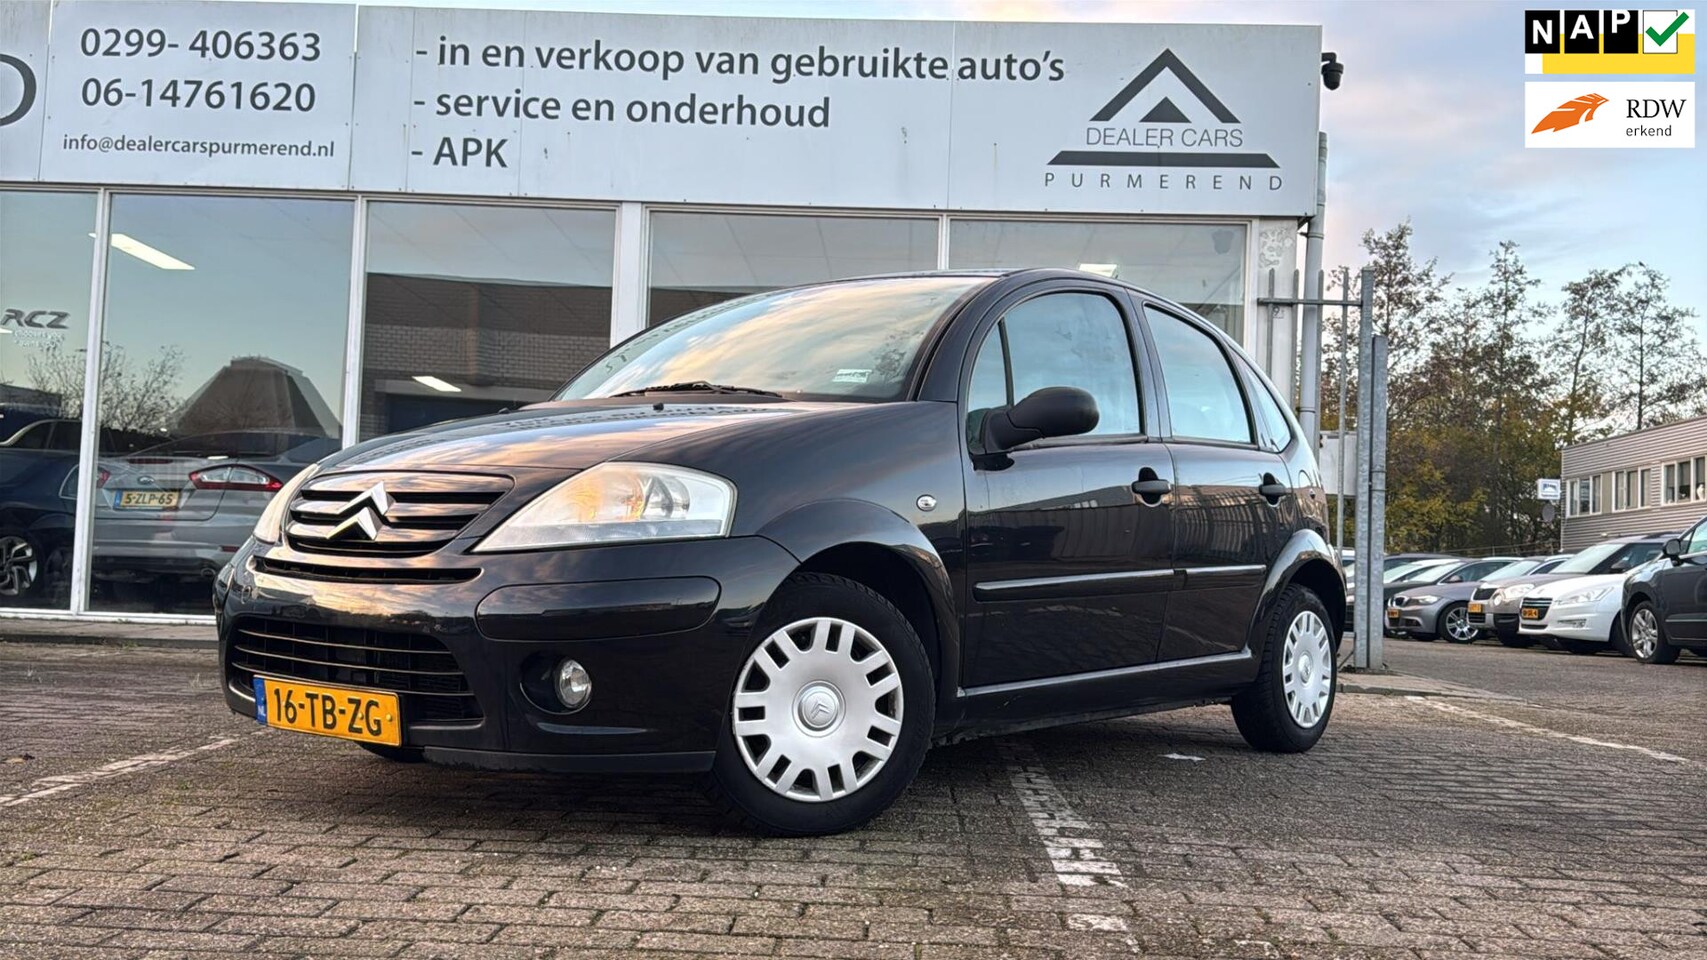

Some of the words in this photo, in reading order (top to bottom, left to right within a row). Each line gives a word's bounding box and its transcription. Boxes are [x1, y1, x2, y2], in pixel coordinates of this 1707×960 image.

[80, 28, 179, 58] 0299-
[188, 30, 321, 62] 406363
[438, 35, 470, 66] in
[481, 45, 525, 68] en
[535, 39, 685, 81] verkoop
[695, 51, 759, 75] van
[770, 45, 949, 84] gebruikte
[957, 50, 1065, 82] auto's
[81, 77, 316, 112] 06-14761620
[436, 88, 561, 120] service
[571, 98, 614, 122] en
[626, 93, 830, 128] onderhoud
[63, 133, 335, 158] info@dealercarspurmerend.nl
[433, 136, 508, 168] APK
[1086, 126, 1174, 147] DEALER
[1181, 128, 1244, 148] CARS
[1044, 172, 1283, 191] PURMEREND
[0, 308, 71, 329] RCZ
[124, 493, 174, 505] 5-ZLP-65
[273, 688, 382, 736] 16-TB-ZG
